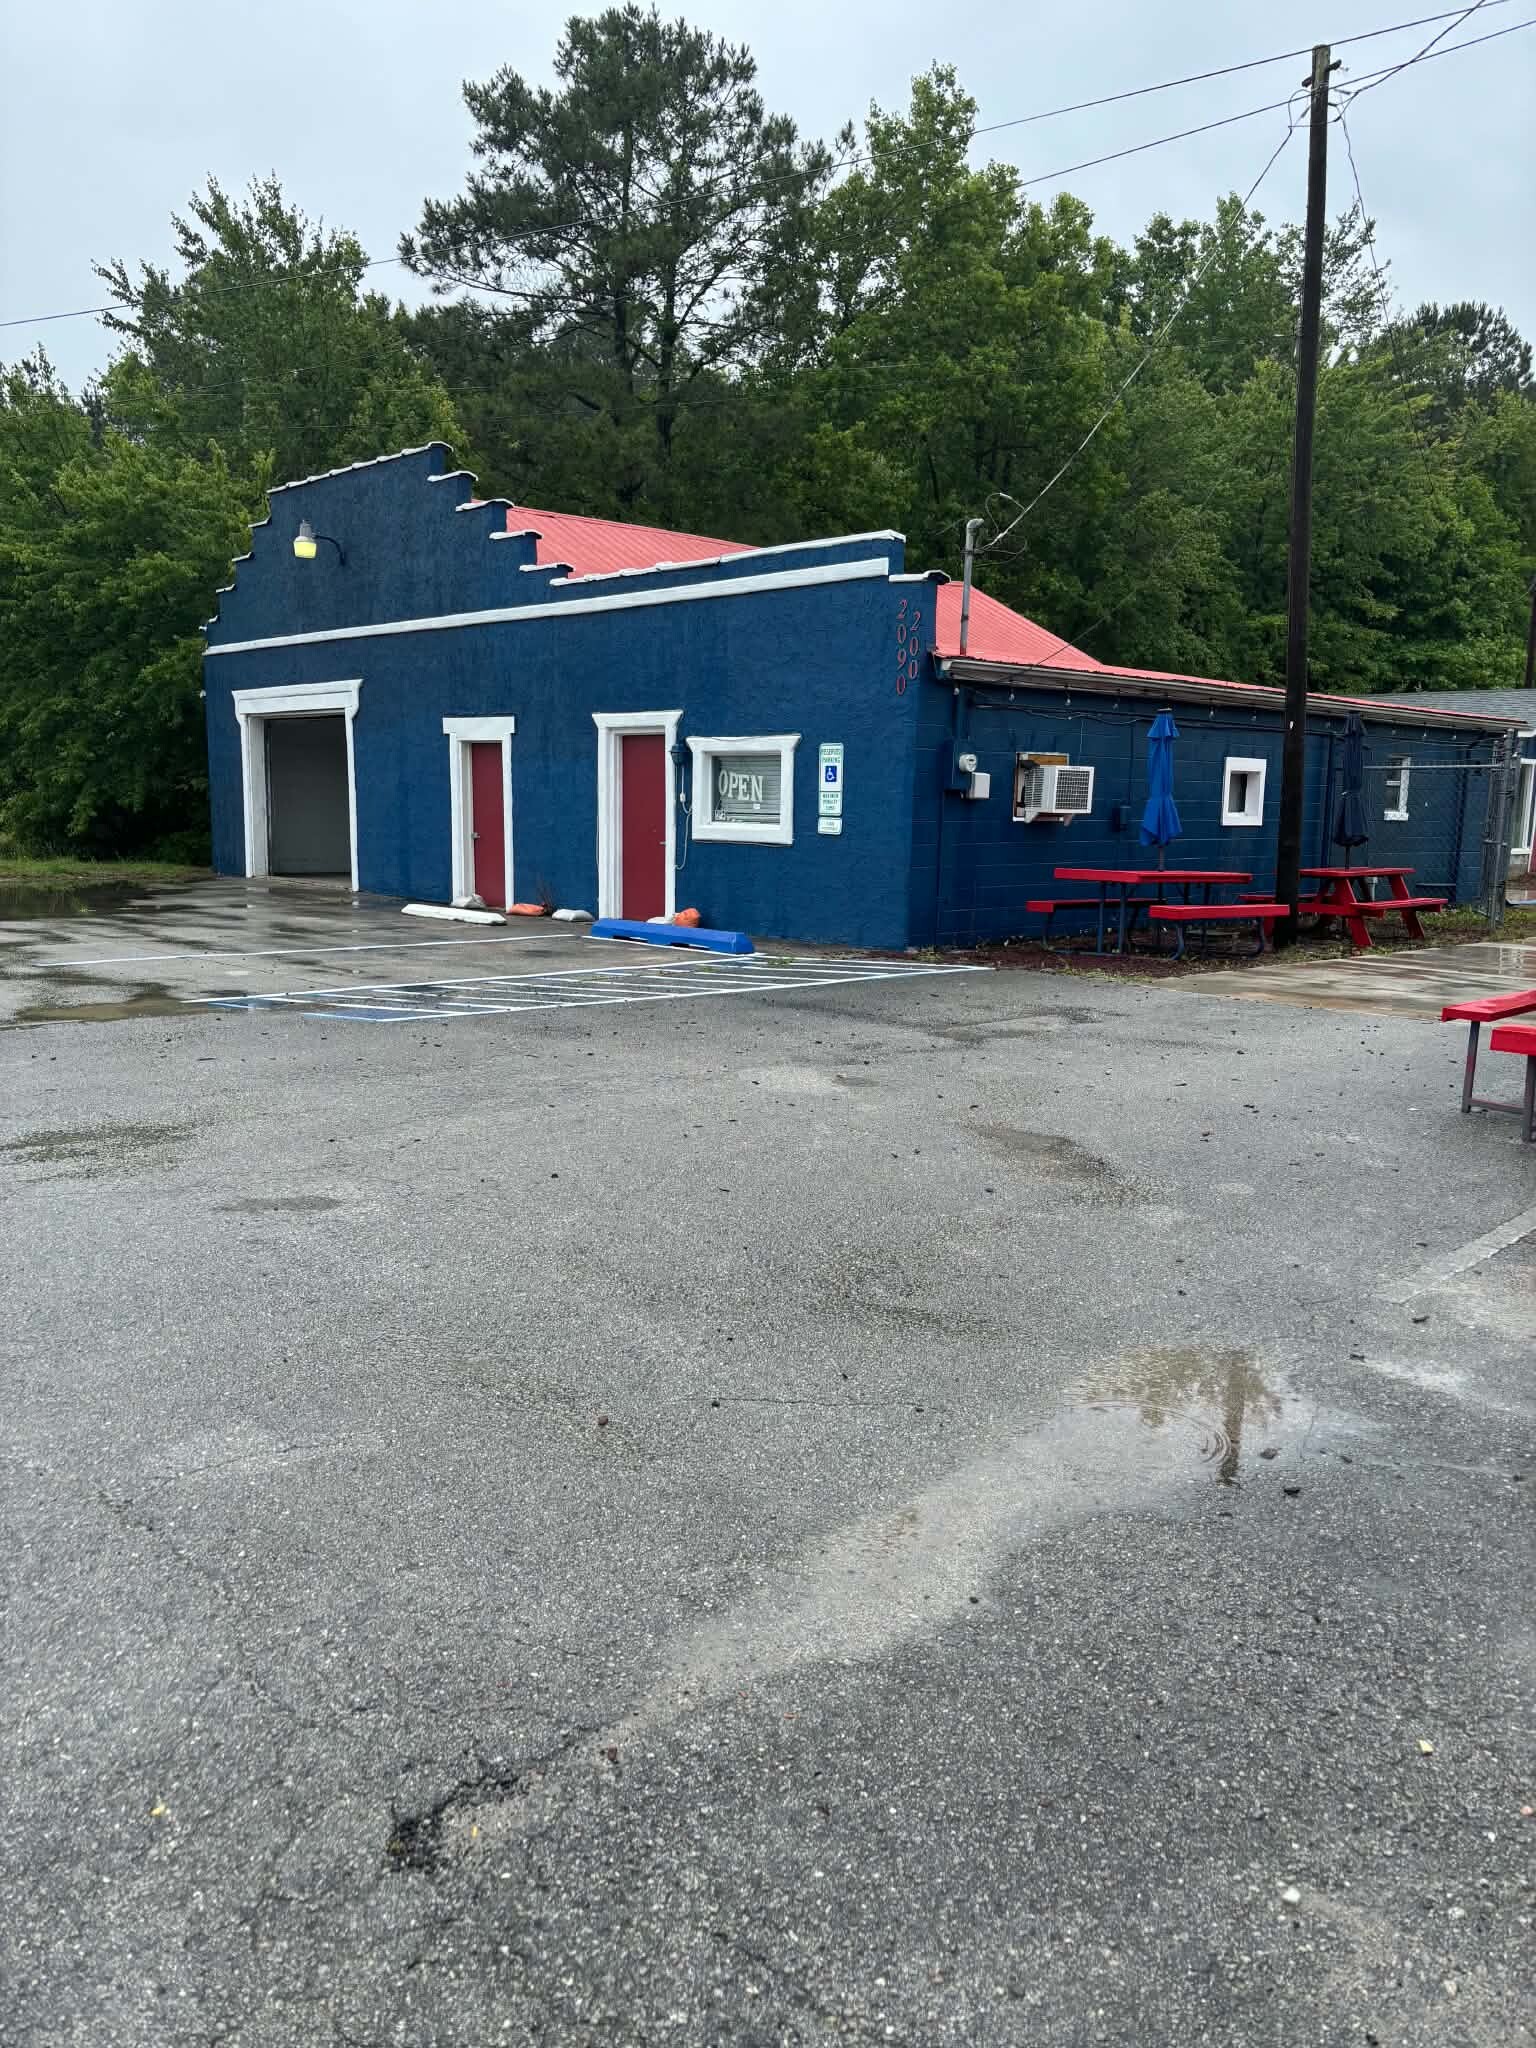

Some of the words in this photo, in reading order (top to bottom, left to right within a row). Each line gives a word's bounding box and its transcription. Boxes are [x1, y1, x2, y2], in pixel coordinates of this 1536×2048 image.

[896, 599, 908, 696] 2090
[908, 611, 921, 680] 200
[719, 769, 764, 802] OPEN
